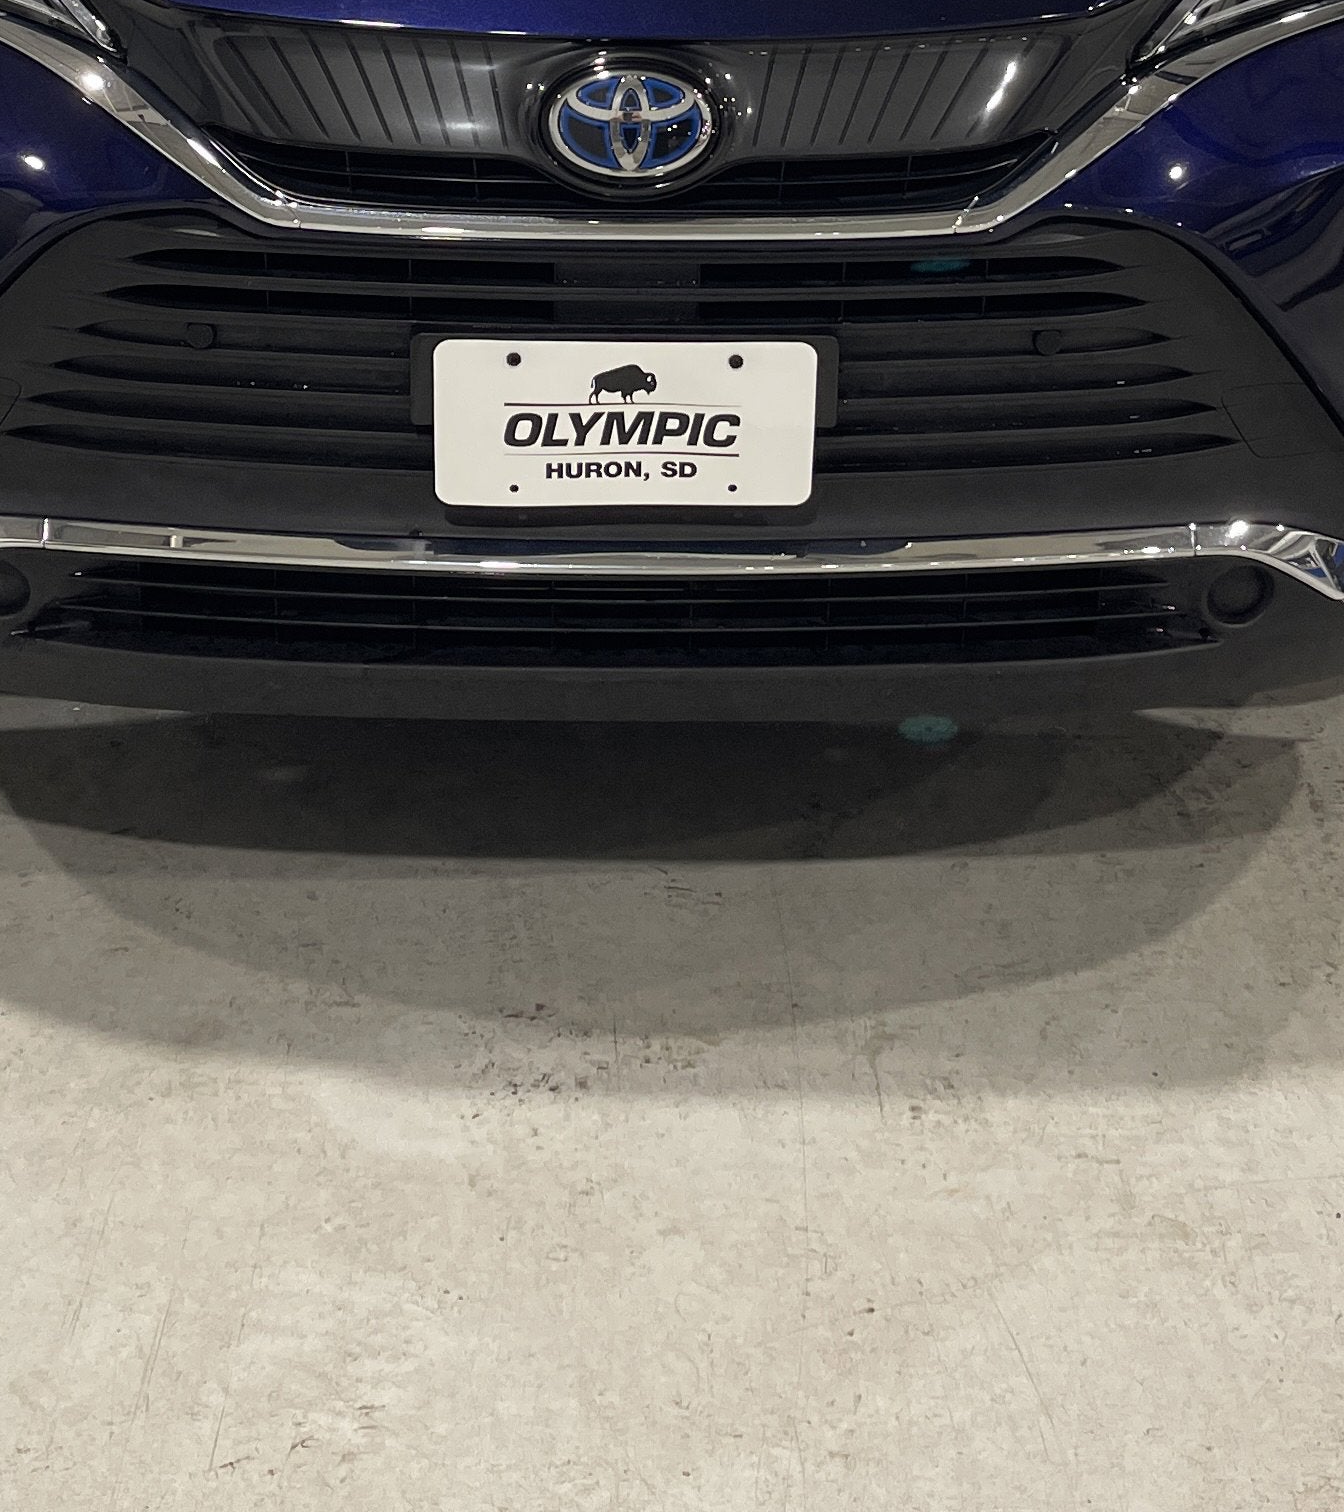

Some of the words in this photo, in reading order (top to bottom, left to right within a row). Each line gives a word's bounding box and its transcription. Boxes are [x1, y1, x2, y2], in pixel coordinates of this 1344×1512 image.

[503, 411, 742, 448] OLYMPIC
[545, 461, 650, 481] HURON,
[660, 461, 698, 479] SD
